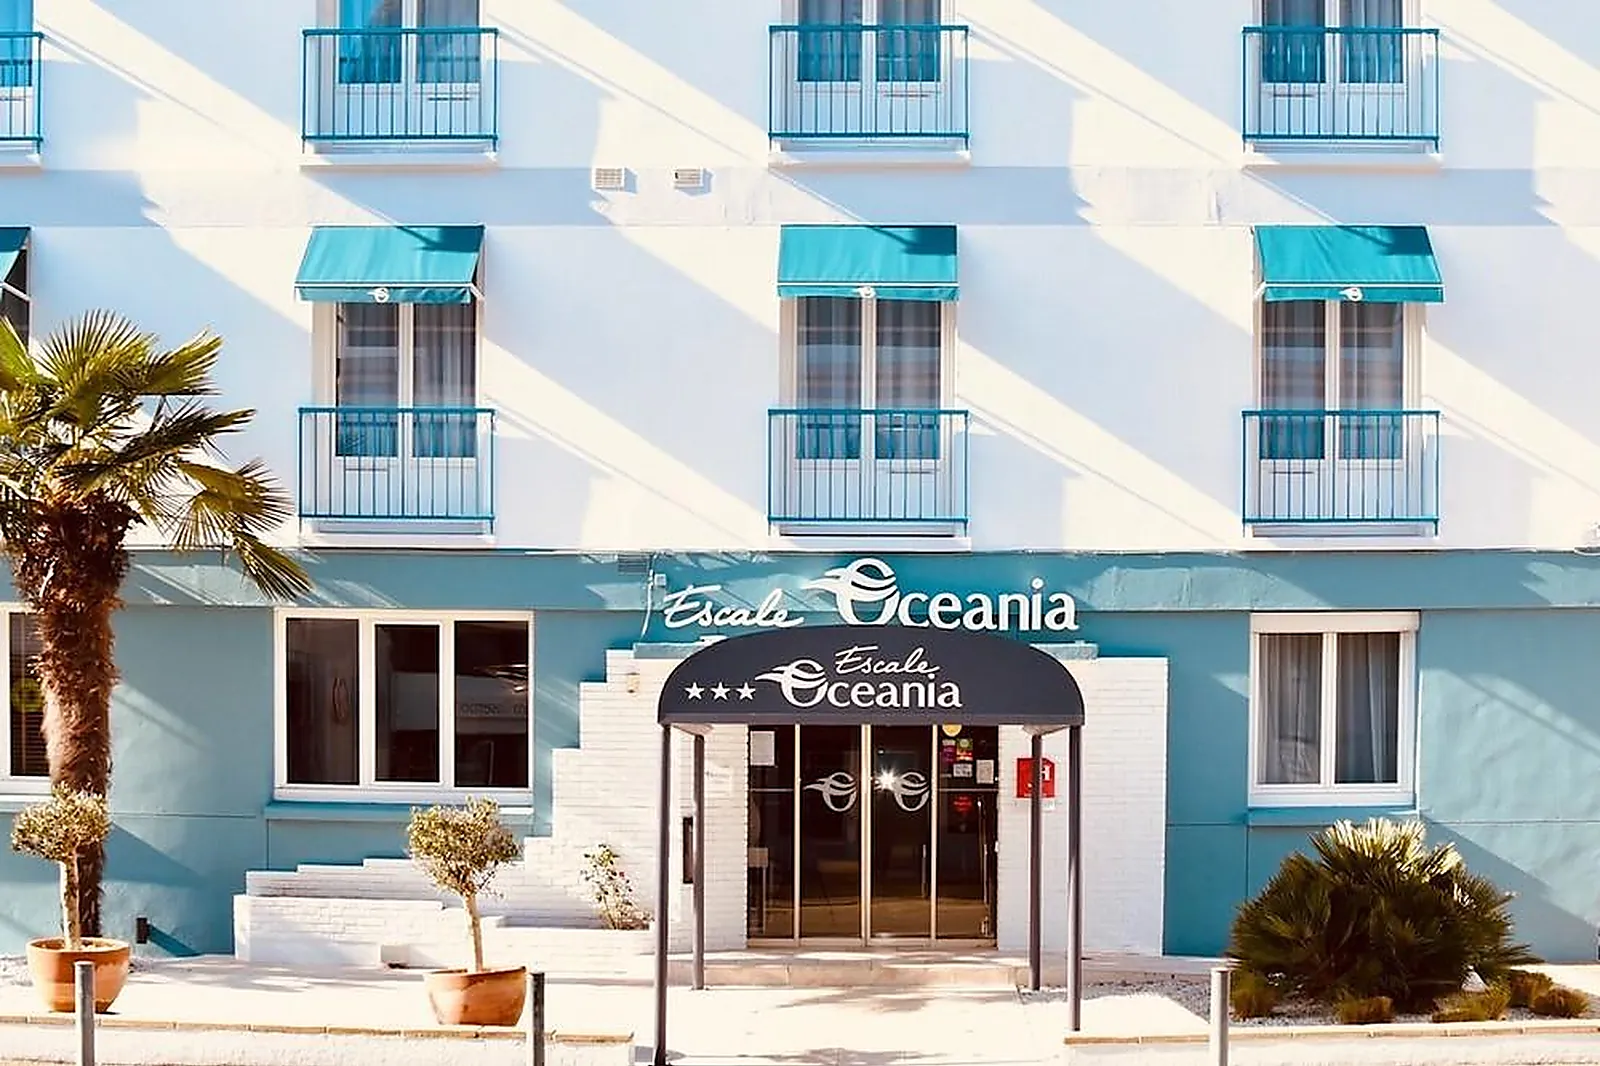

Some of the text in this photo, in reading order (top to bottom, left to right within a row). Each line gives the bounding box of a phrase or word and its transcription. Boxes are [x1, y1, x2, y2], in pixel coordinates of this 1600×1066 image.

[662, 558, 1078, 631] Escale Oceania
[755, 660, 963, 709] Oceania
[834, 645, 940, 676] Escale
